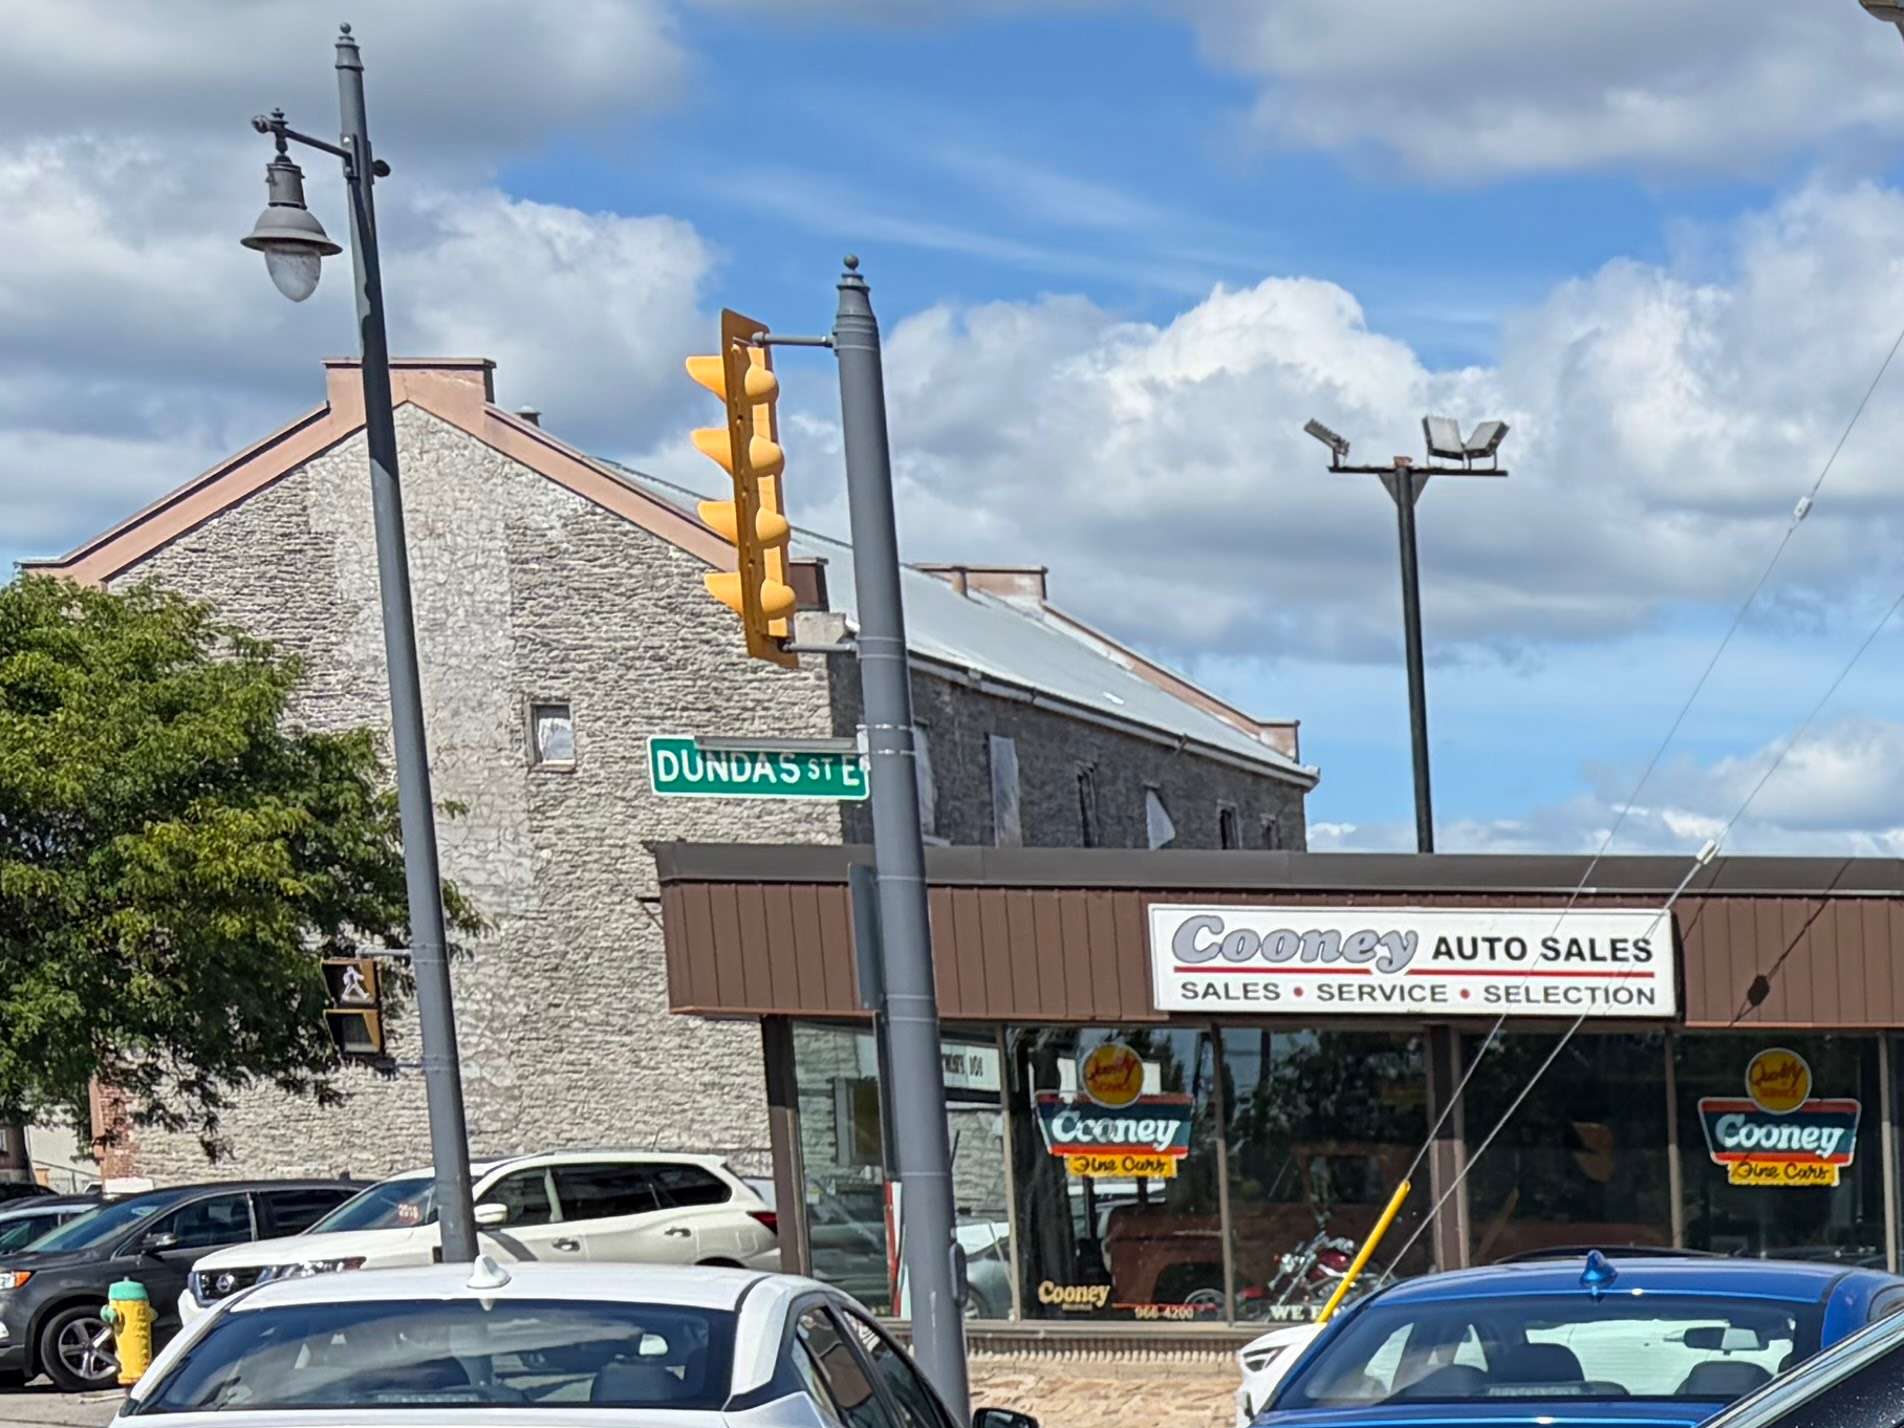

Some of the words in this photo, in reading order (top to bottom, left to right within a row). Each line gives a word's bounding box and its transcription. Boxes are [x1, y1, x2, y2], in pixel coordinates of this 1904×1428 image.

[656, 749, 801, 784] DUNDAS
[807, 757, 834, 781] ST
[841, 754, 861, 786] E
[1171, 914, 1419, 975] Cooney
[1431, 936, 1528, 962] AUTO
[1540, 936, 1654, 963] SALES
[1180, 981, 1281, 1002] SALES
[1316, 982, 1448, 1003] SERVICE
[1483, 984, 1656, 1006] SELECTION
[1051, 1110, 1181, 1152] Cooney
[1715, 1113, 1845, 1160] Cooney
[1037, 1279, 1110, 1306] Cooney
